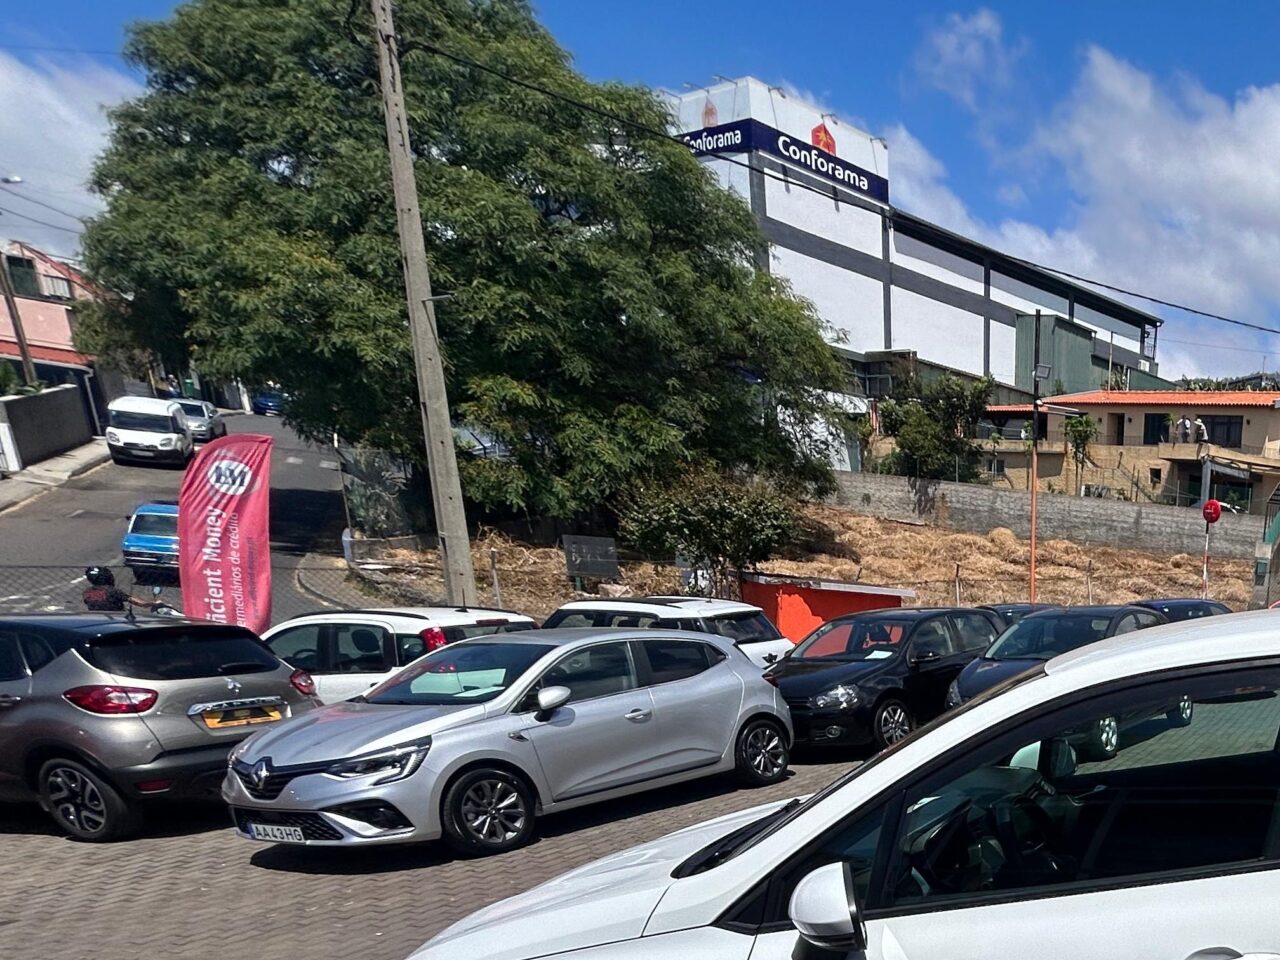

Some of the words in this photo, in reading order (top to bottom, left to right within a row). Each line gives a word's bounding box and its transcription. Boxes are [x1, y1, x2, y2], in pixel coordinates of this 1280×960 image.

[777, 135, 870, 191] Conforama
[203, 507, 226, 562] Money
[228, 512, 240, 549] crédito
[228, 551, 241, 565] de
[203, 568, 227, 624] ficient
[230, 568, 246, 627] ermediários
